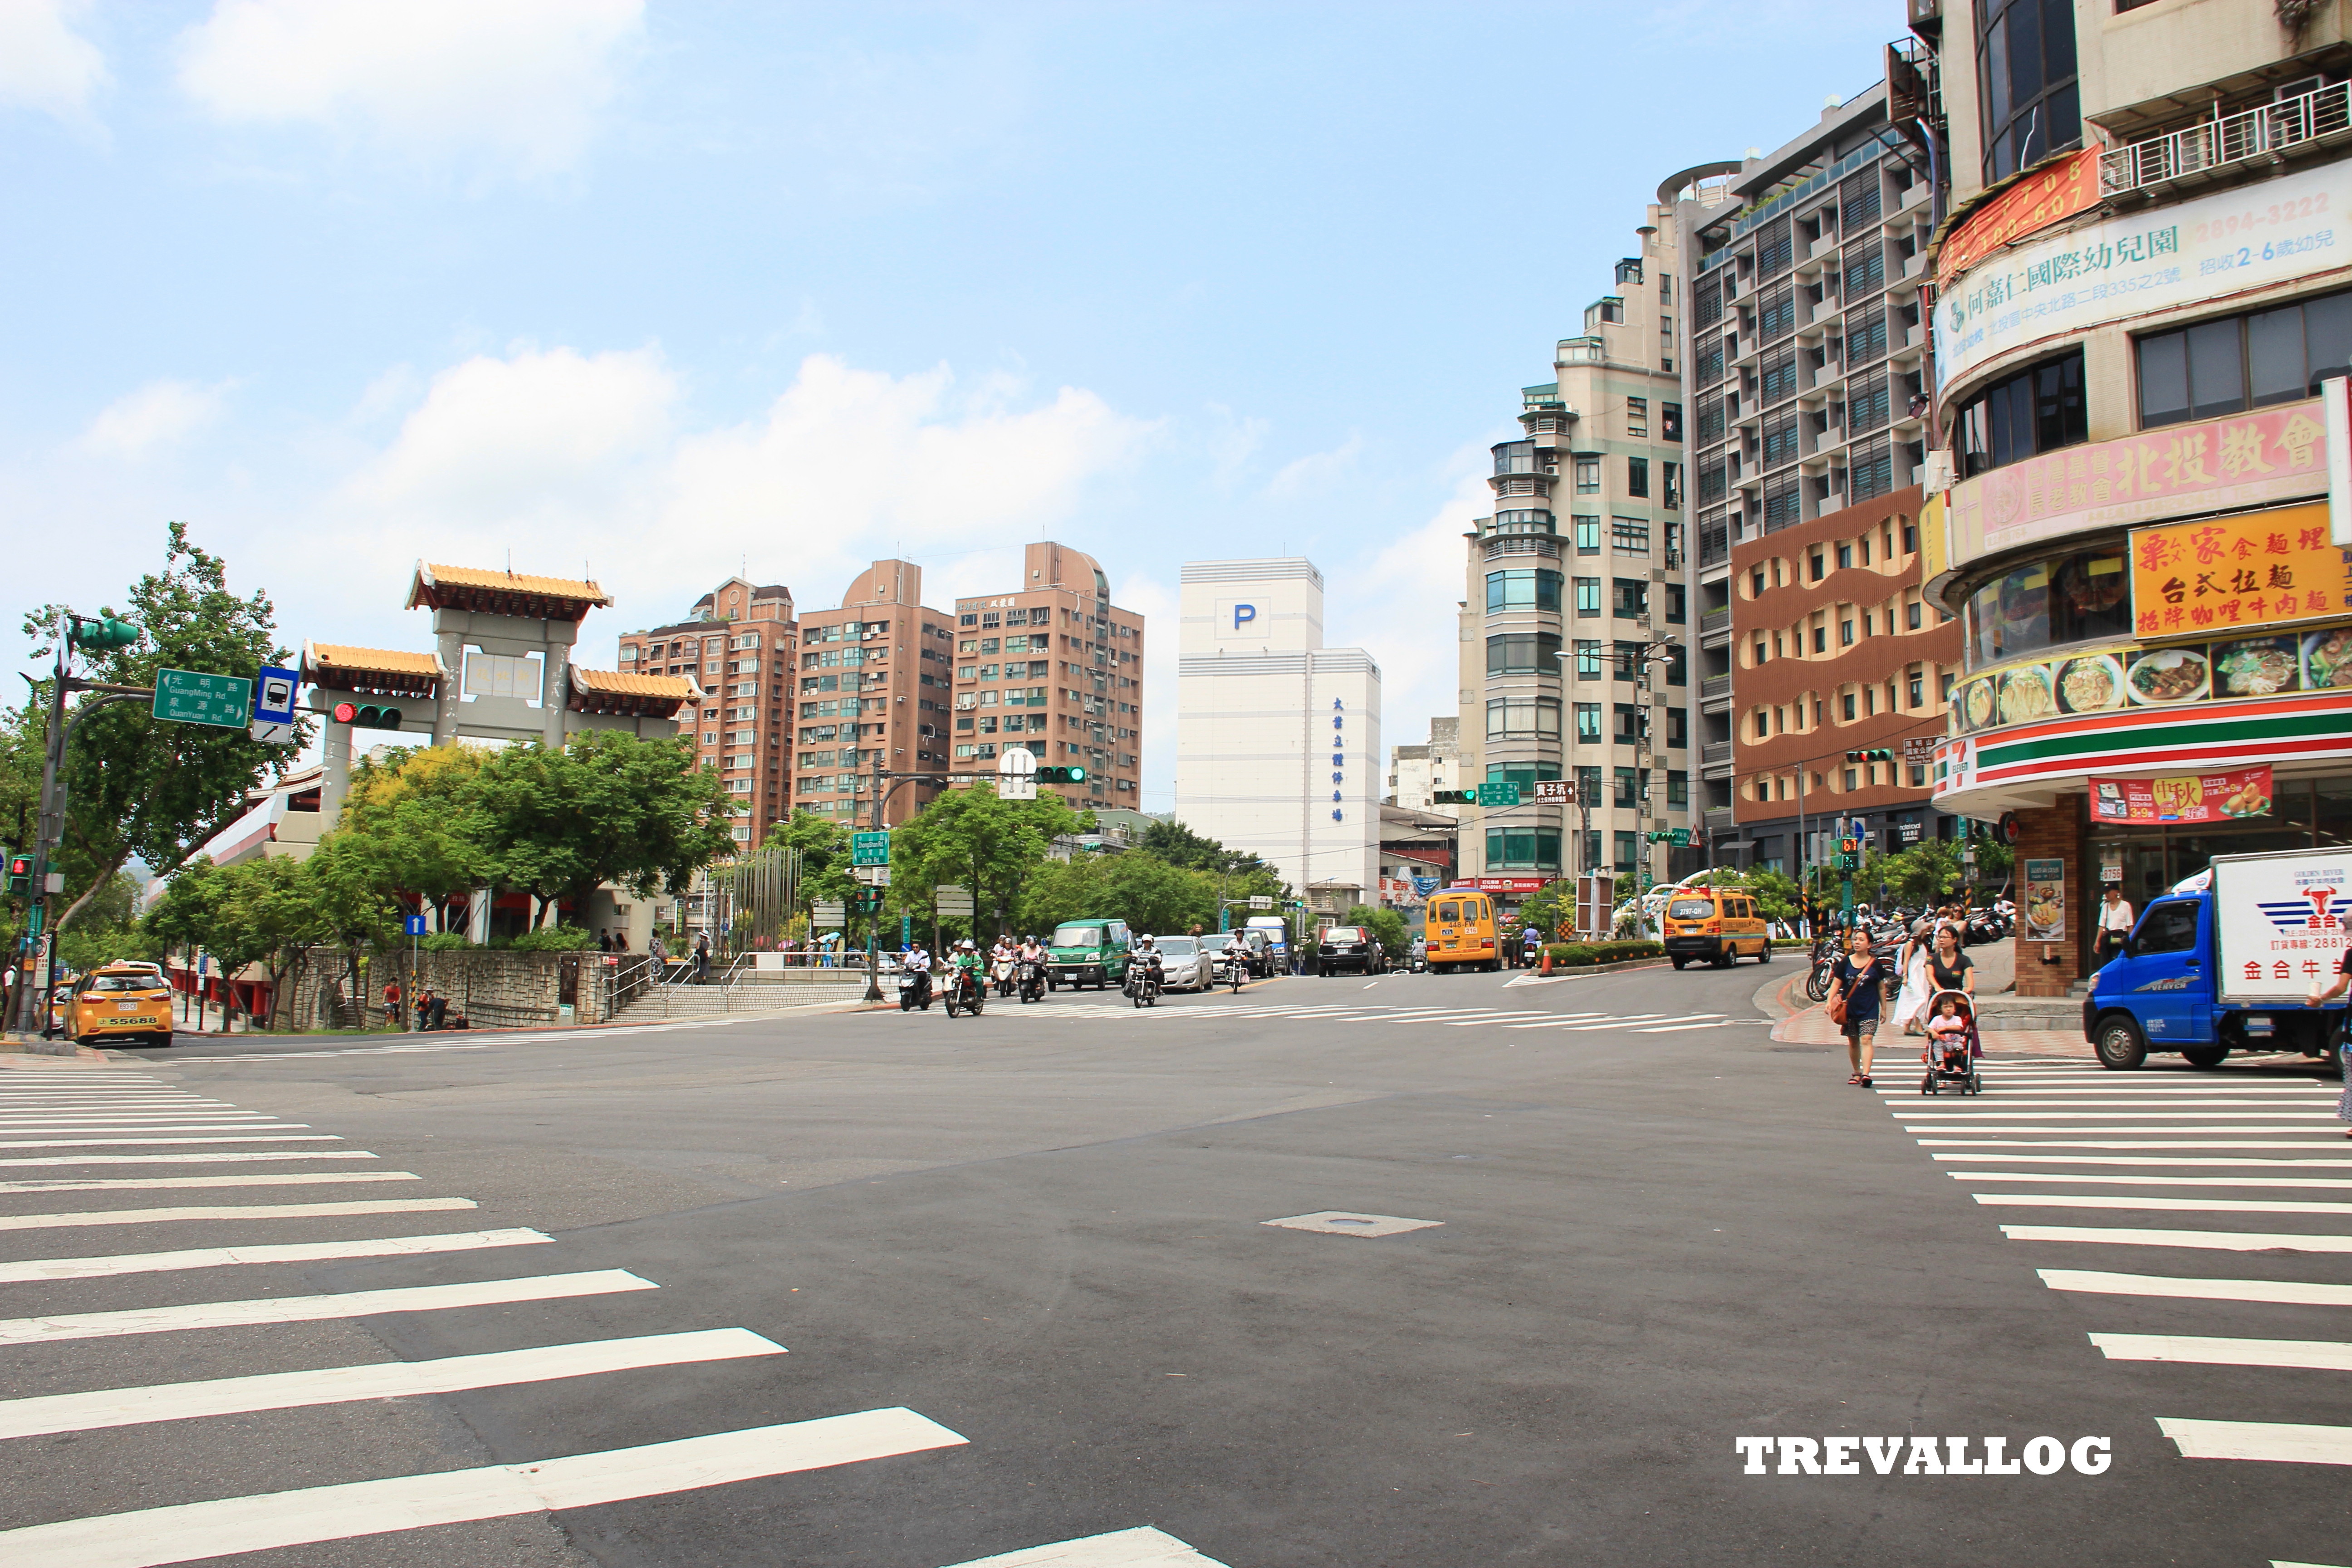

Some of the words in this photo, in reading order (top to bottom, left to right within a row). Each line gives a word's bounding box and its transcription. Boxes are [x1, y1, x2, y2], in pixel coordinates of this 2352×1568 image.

[2196, 192, 2329, 243] 2894-3222
[2200, 229, 2335, 276] 招收2-6歲幼兒
[1966, 225, 2179, 320] 何嘉仁國際幼兒園
[1987, 267, 2181, 337] 北投區中央北路二段335之2號
[2028, 450, 2110, 490] 台灣基督
[2116, 414, 2326, 497] 北投教會
[2029, 478, 2111, 517] 長老教會
[2161, 564, 2297, 604] 台式拉麵
[1235, 604, 1256, 629] P
[2137, 590, 2330, 632] 招牌咖哩牛肉麵
[169, 686, 212, 699] GuangMing
[215, 691, 227, 700] Rd.
[172, 675, 238, 692] 光明路
[168, 697, 235, 714] 泉源路
[169, 709, 205, 719] QuanYuan
[211, 714, 224, 722] Rd.
[1332, 697, 1344, 822] 大業立體停車場
[1536, 784, 1565, 796] 貴子坑
[2156, 780, 2198, 809] 中秋
[2307, 914, 2336, 929] 金合
